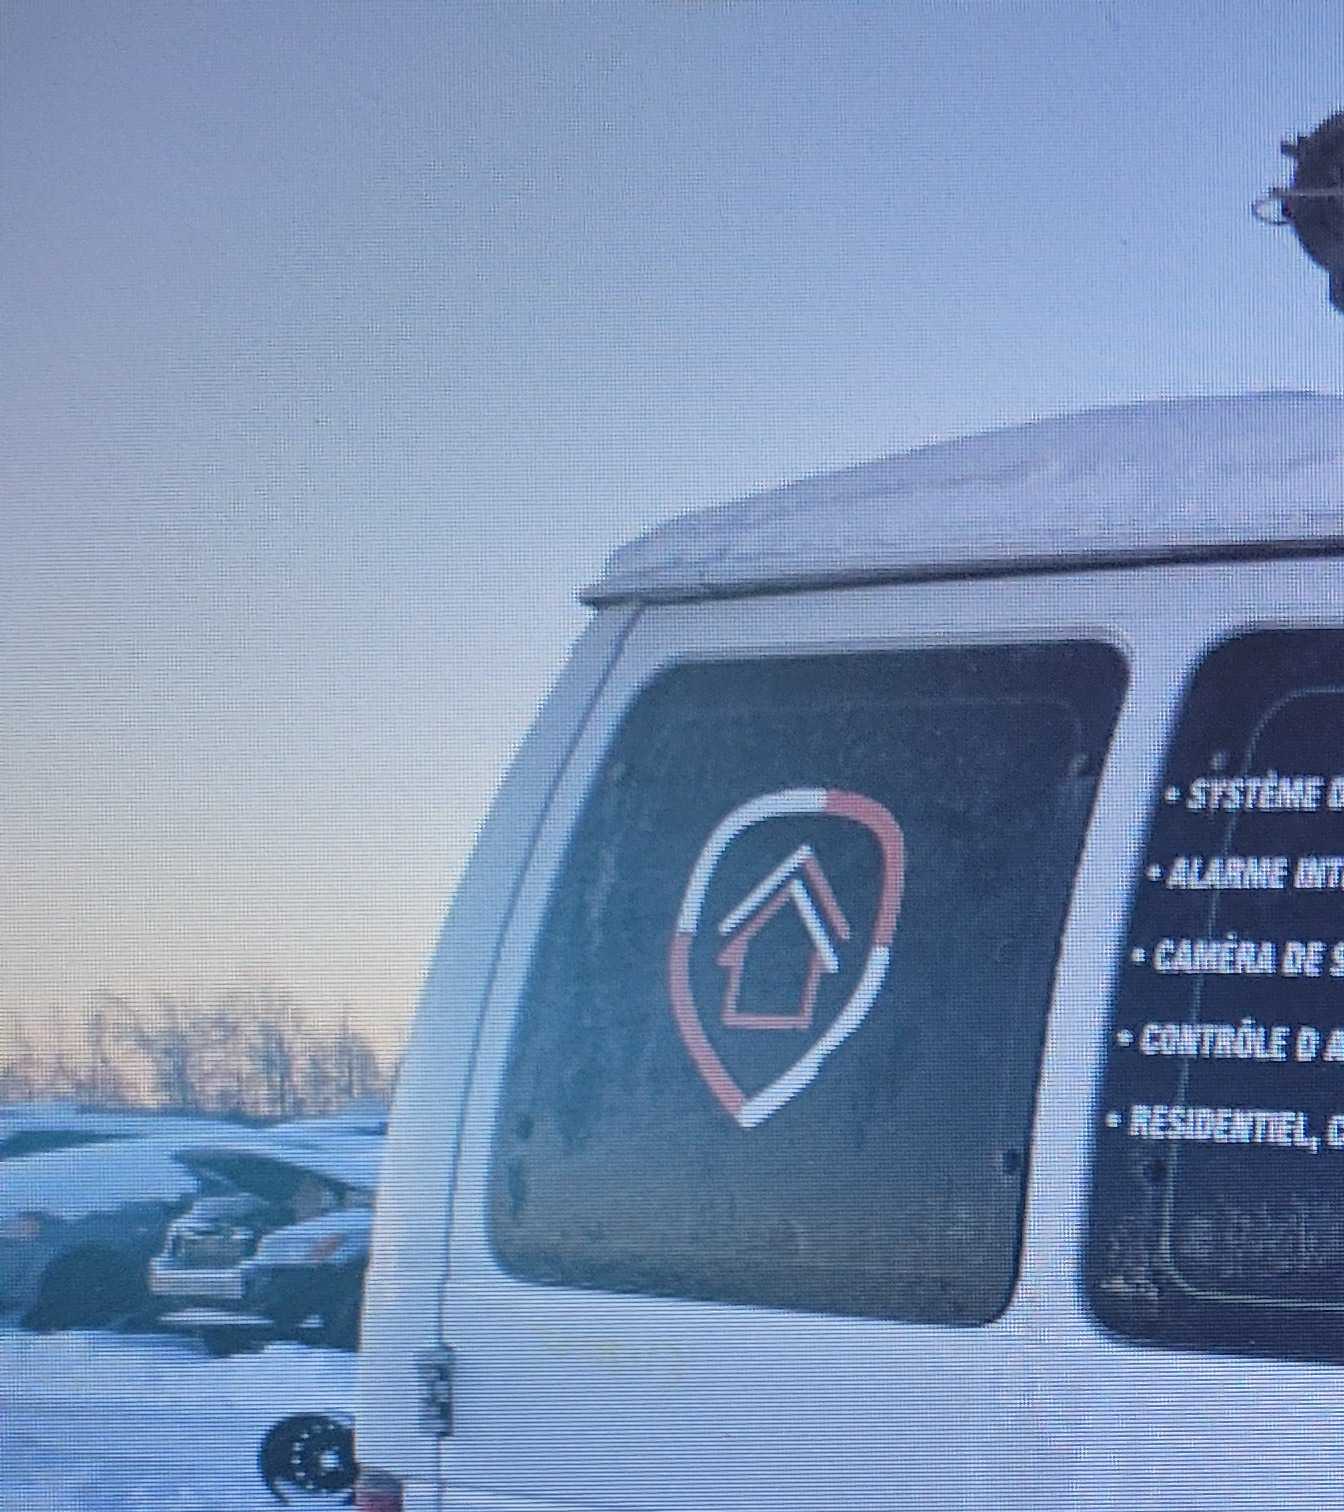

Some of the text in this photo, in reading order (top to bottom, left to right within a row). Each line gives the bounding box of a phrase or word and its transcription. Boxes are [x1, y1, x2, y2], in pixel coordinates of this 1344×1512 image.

[1187, 769, 1320, 812] SYSTÈME
[1167, 857, 1288, 890] ALARME
[1153, 932, 1276, 977] CAMÉRA
[1282, 939, 1325, 978] DE
[1140, 1017, 1288, 1063] CONTRÔLE
